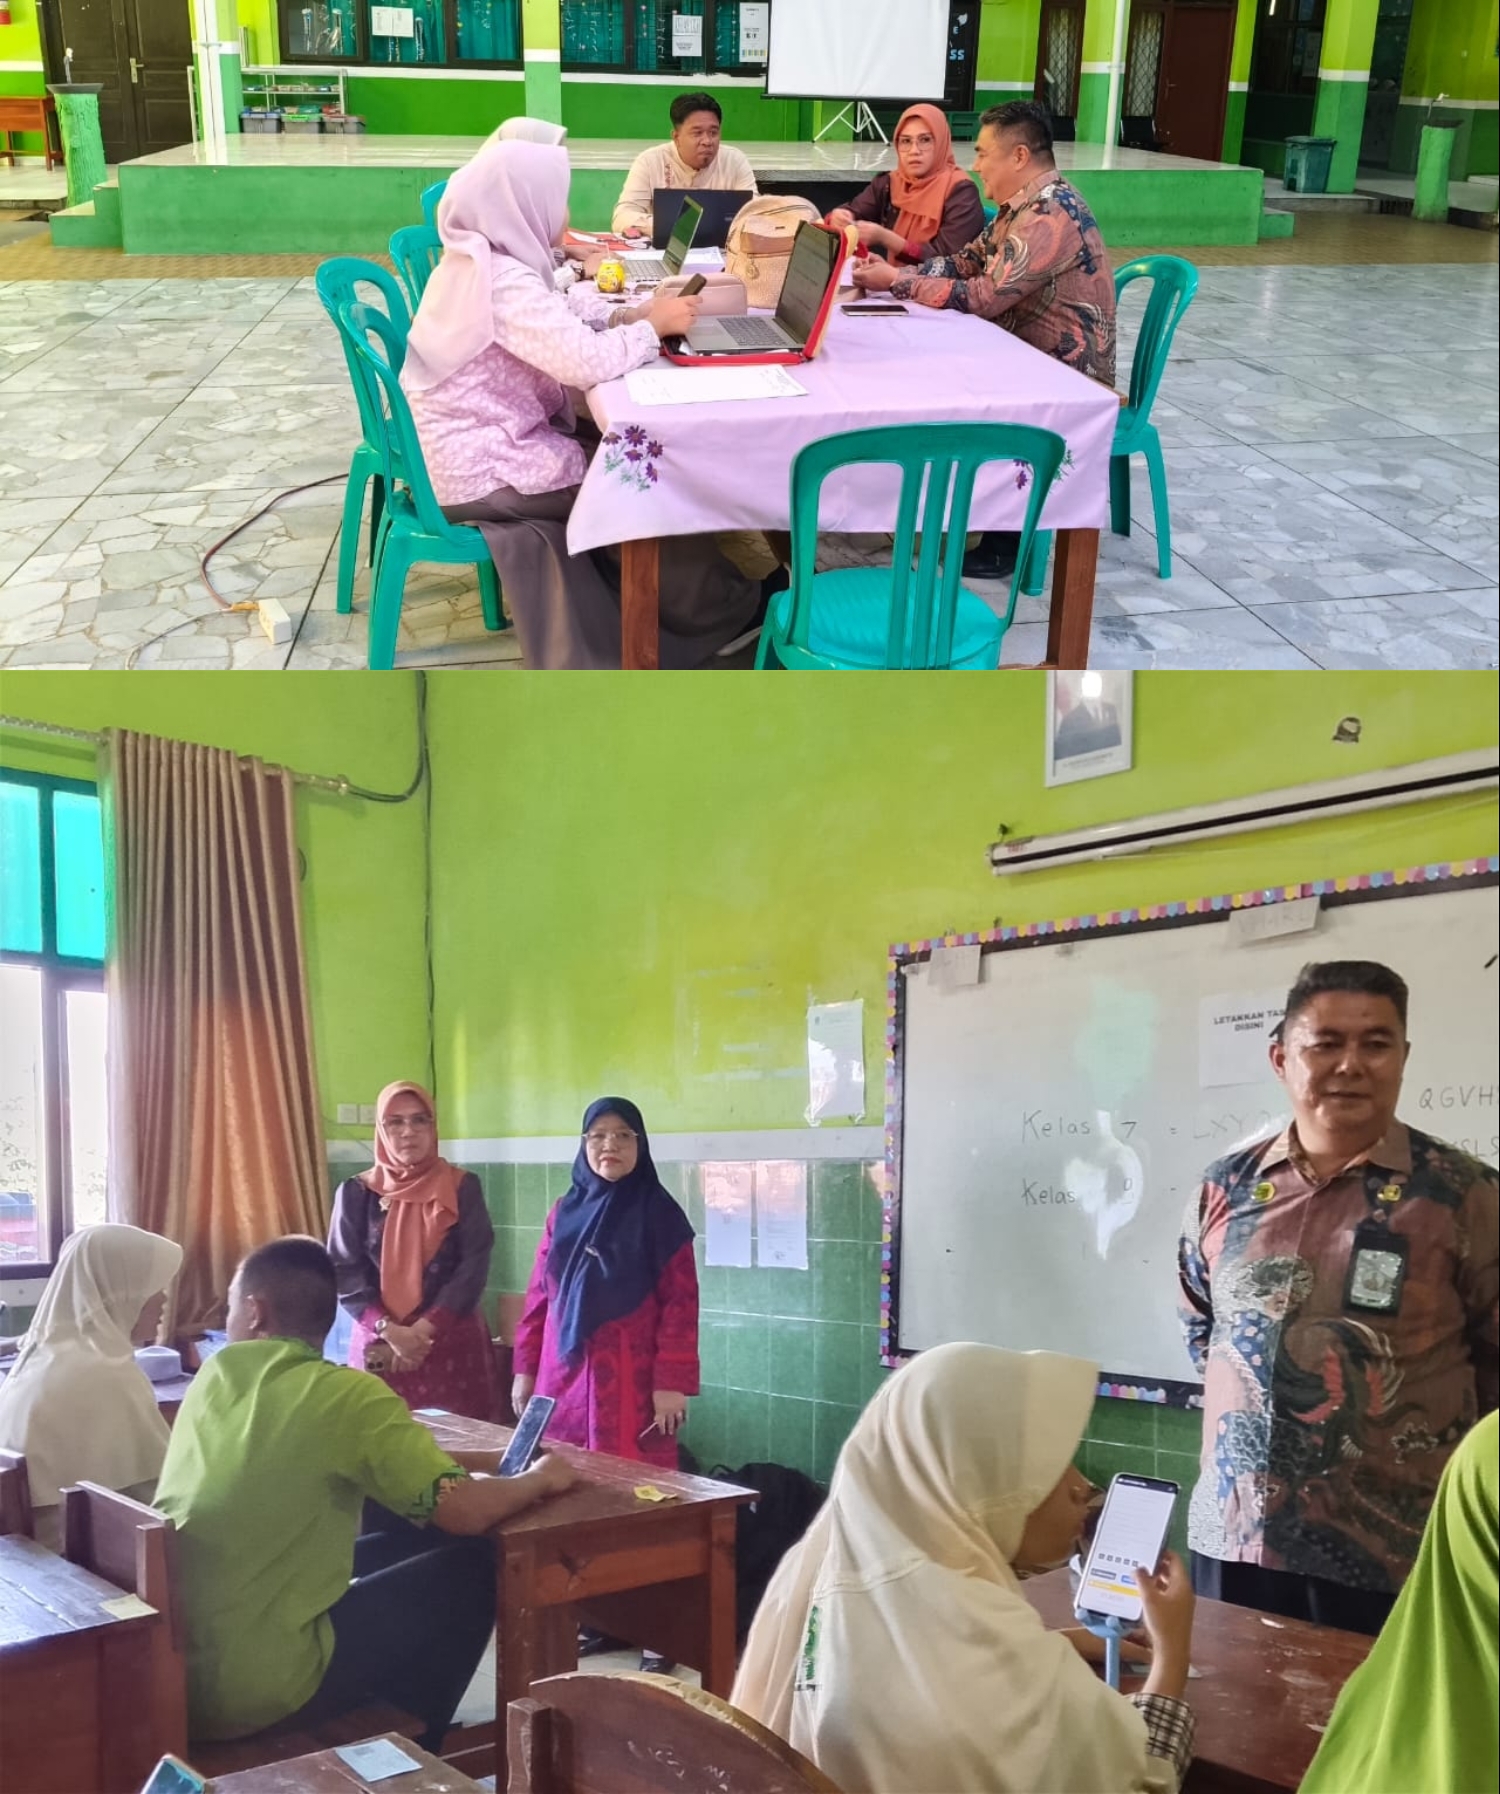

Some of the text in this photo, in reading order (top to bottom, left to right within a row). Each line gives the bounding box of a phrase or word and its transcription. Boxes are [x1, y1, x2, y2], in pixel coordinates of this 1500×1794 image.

[1419, 1084, 1499, 1111] QGVH
[1021, 1109, 1091, 1144] Kelas
[1118, 1120, 1139, 1139] 7
[1454, 1136, 1499, 1157] SLS
[1021, 1177, 1077, 1206] Kelas
